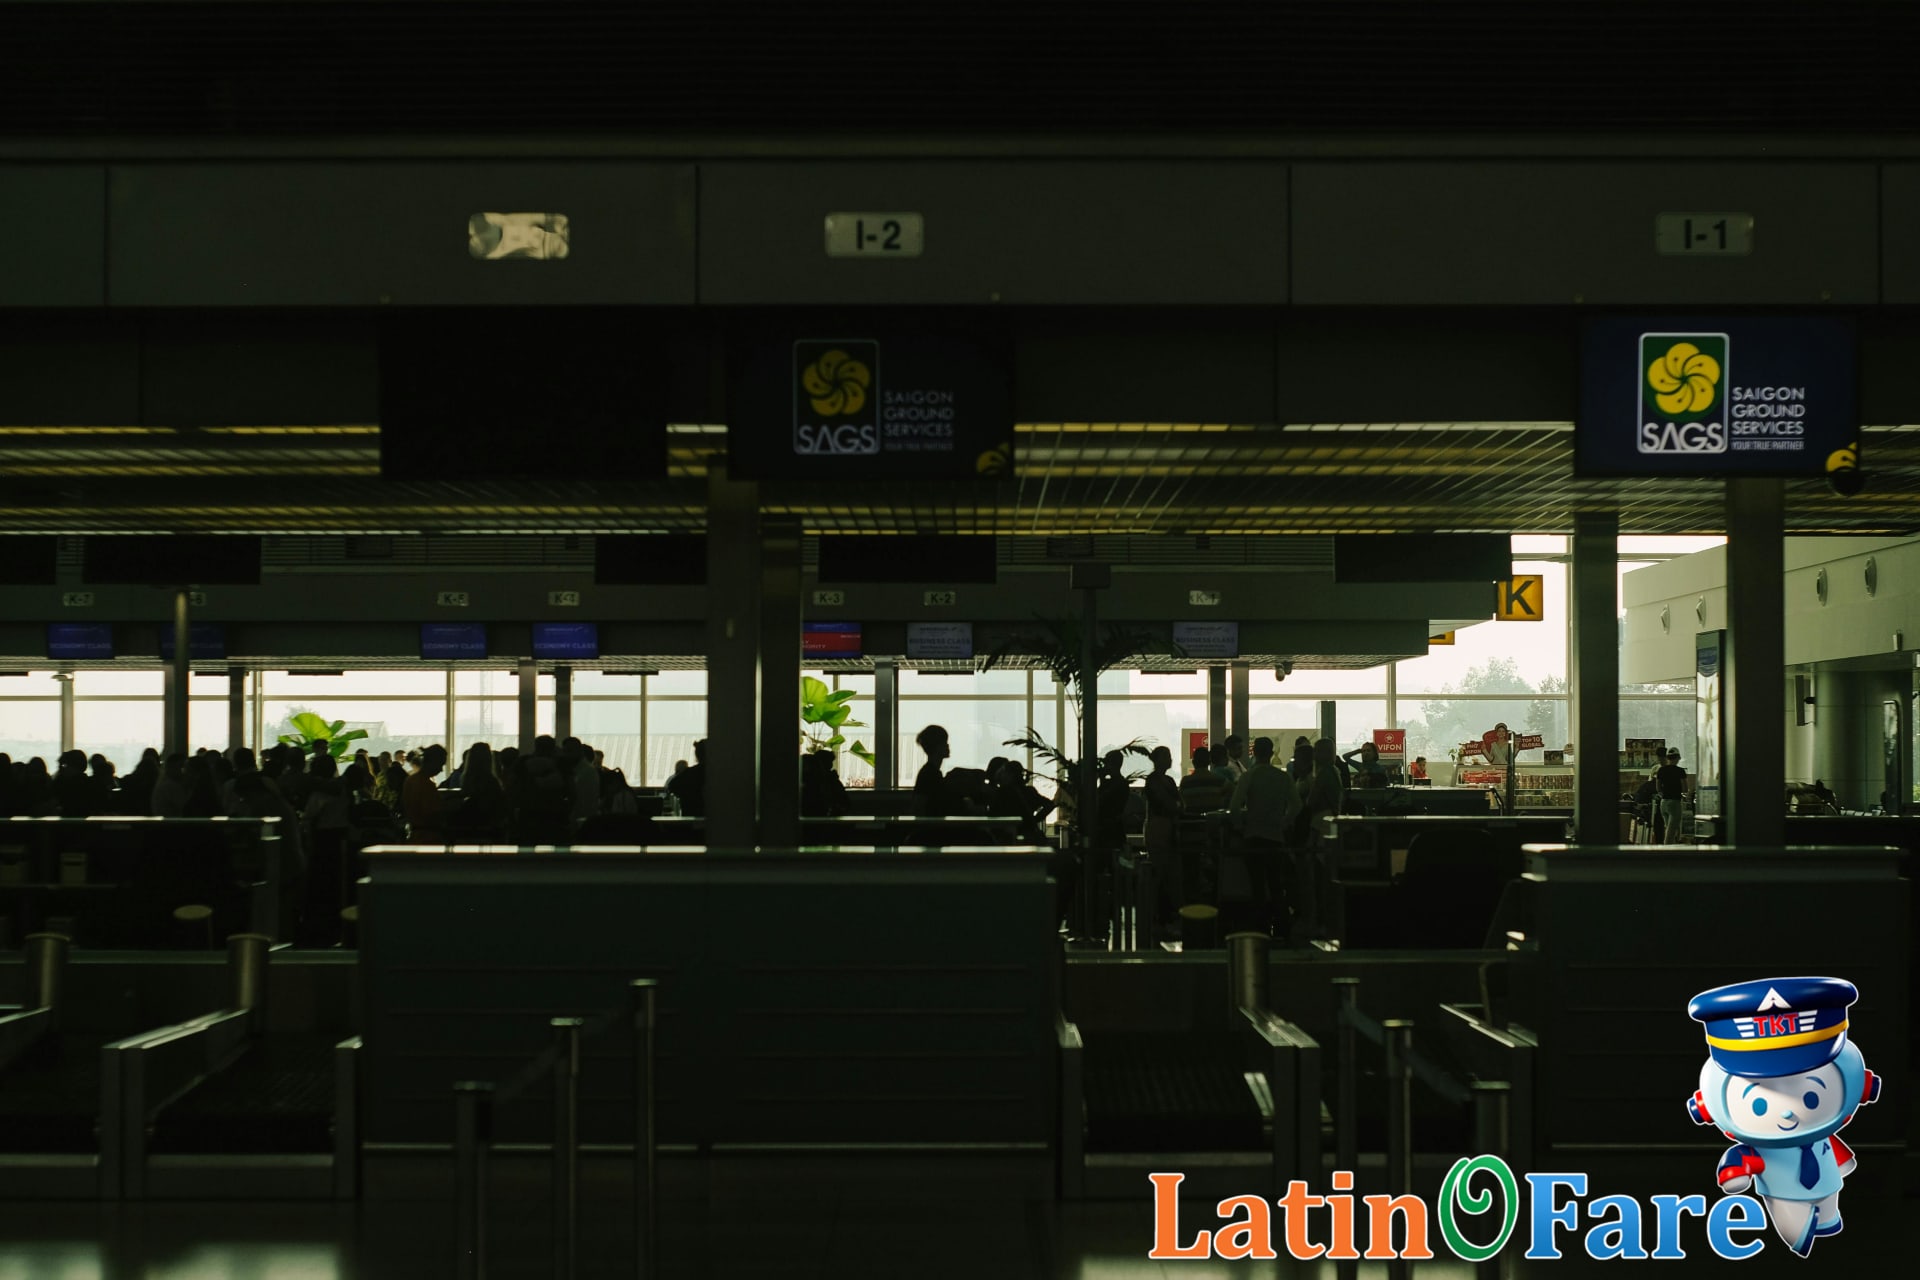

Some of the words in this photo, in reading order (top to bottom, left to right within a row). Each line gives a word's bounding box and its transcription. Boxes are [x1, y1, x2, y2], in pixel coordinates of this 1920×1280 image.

[856, 219, 901, 250] I-2
[1684, 219, 1727, 250] I-1
[884, 390, 954, 404] SAIGON
[1732, 386, 1806, 401] SAIGON
[884, 406, 955, 421] GROUND
[1732, 403, 1806, 419] GROUND
[884, 422, 953, 438] SERVICES
[1732, 420, 1805, 436] SERVICES
[798, 422, 877, 454] SAGS
[1642, 421, 1724, 452] SAGS
[819, 592, 841, 604] K-3
[930, 592, 952, 604] K-2
[1505, 580, 1536, 615] K
[1377, 743, 1403, 751] VIFON
